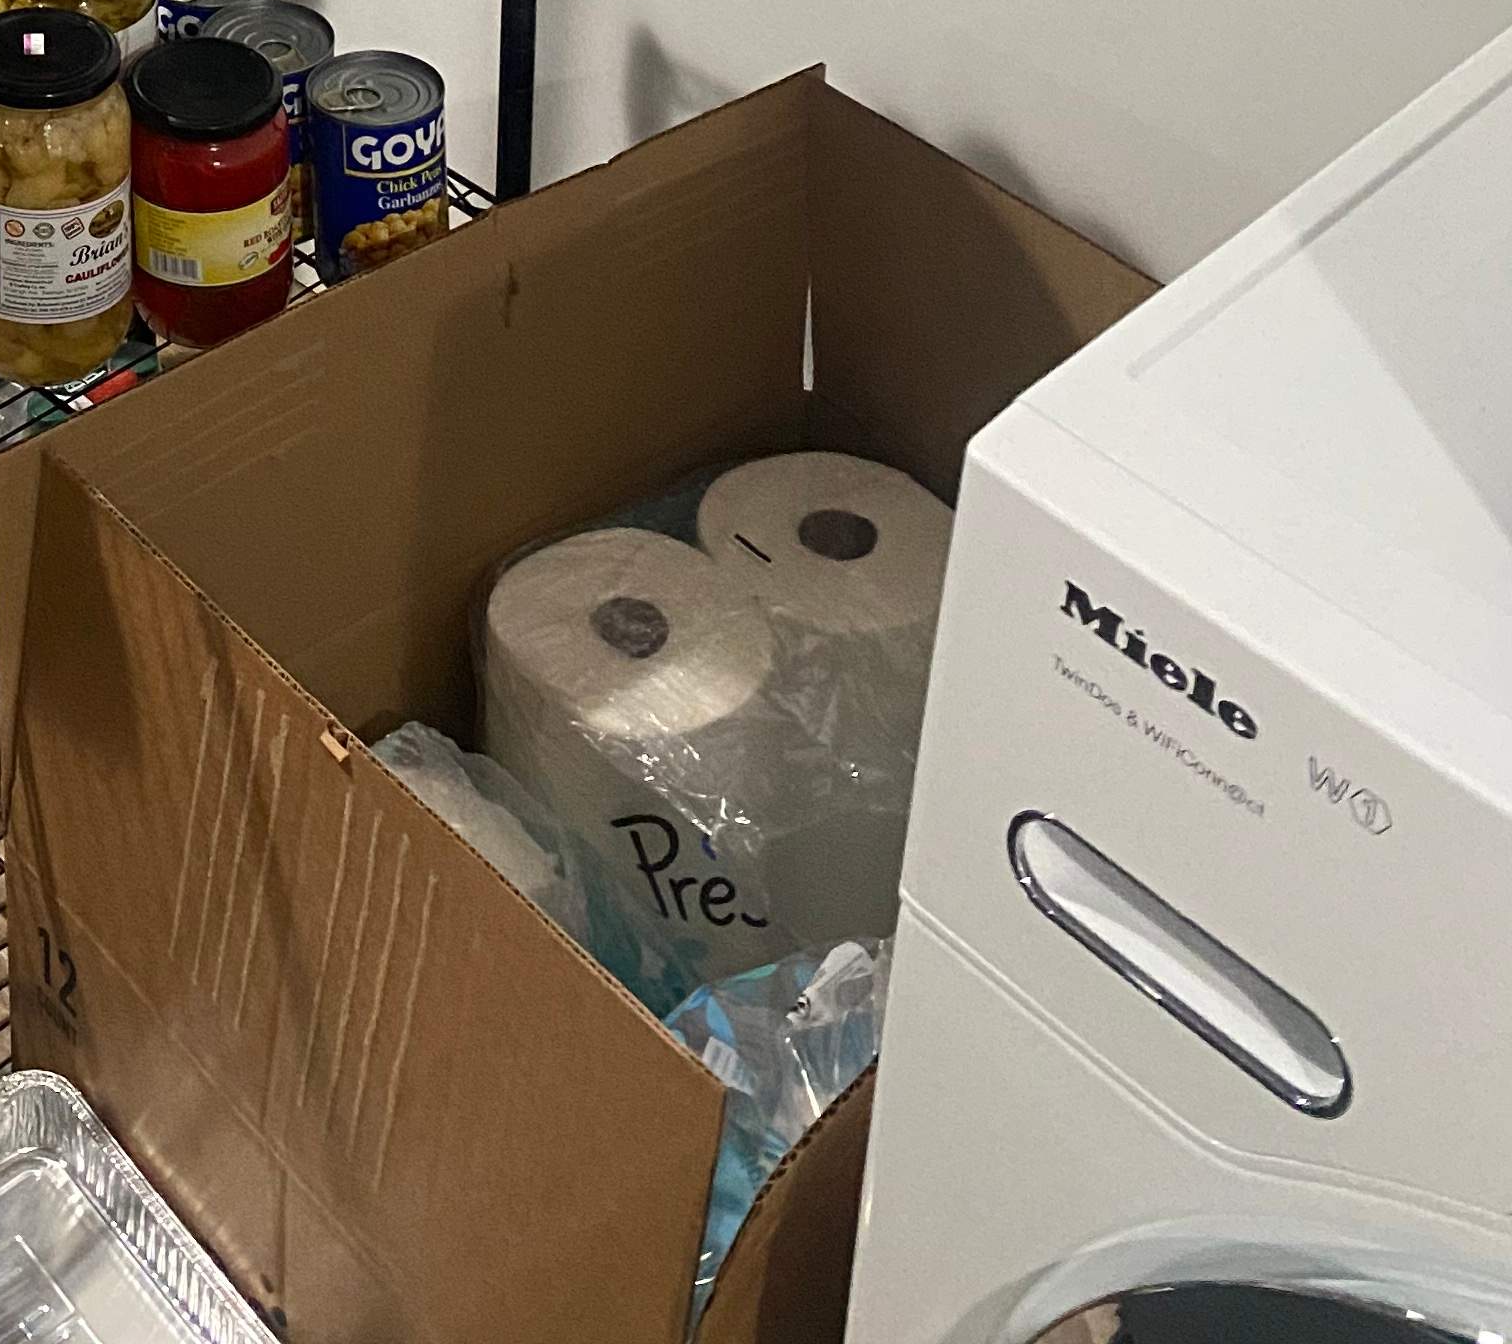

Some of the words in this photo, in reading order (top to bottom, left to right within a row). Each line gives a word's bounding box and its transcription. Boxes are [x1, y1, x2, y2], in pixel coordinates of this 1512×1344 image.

[376, 176, 418, 194] Chick
[1053, 654, 1123, 716] TwinDos
[1126, 710, 1140, 729] &
[1060, 580, 1259, 740] Miele
[37, 926, 78, 1018] 12
